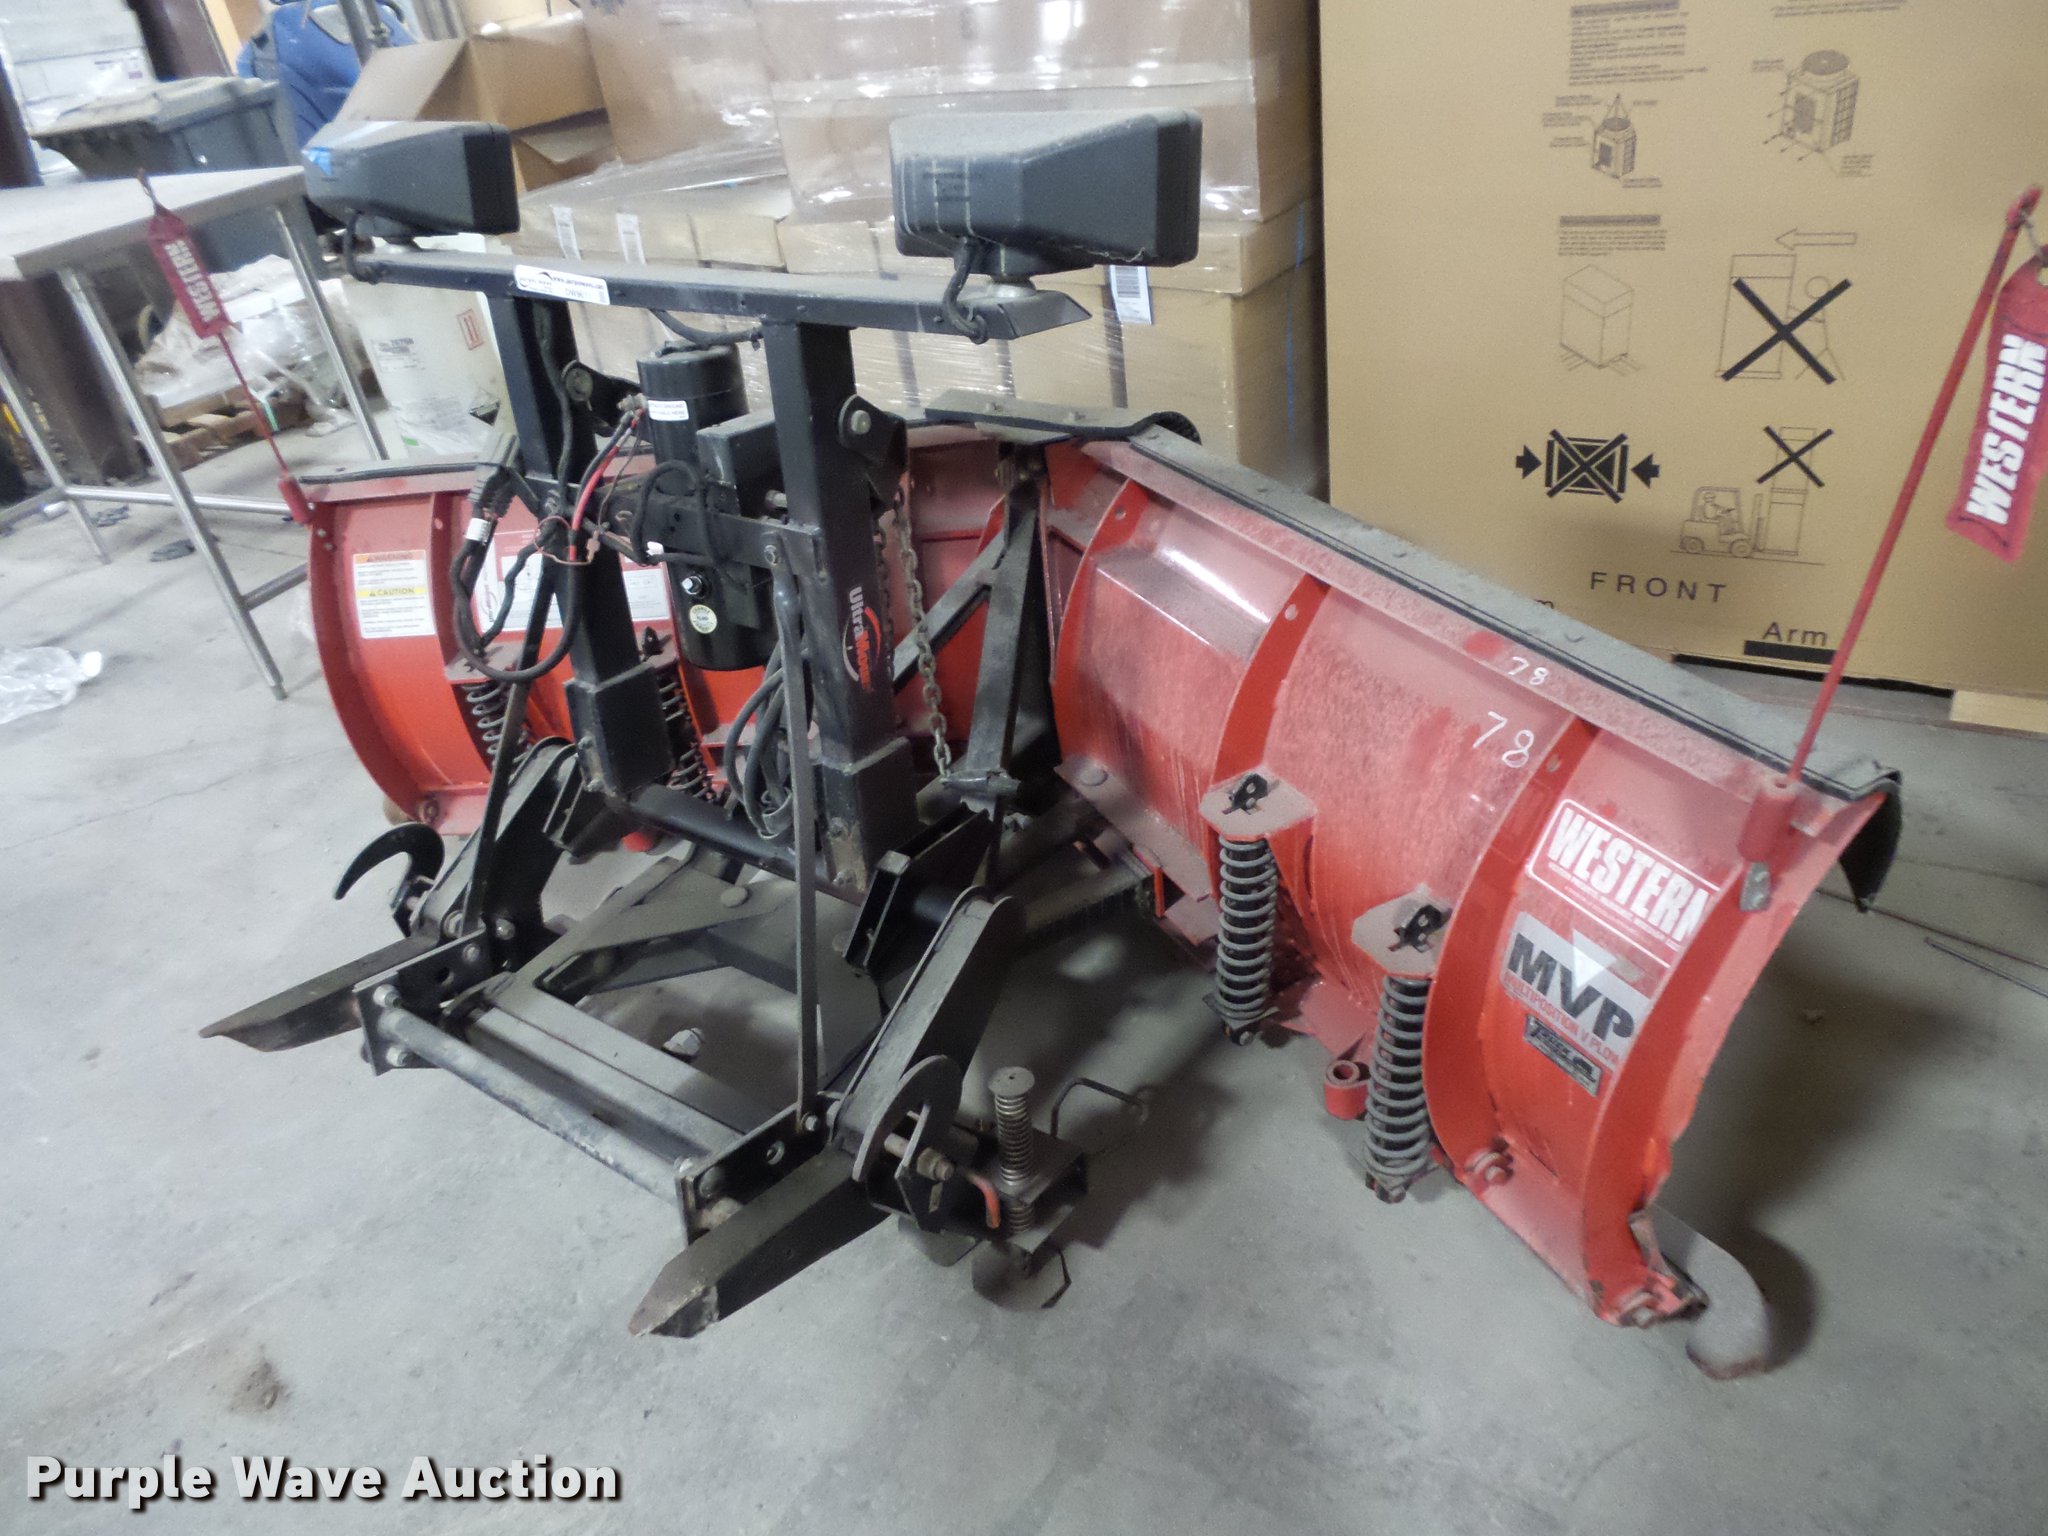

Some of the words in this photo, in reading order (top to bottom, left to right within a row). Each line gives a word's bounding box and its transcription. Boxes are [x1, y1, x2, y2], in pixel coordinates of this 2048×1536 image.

[164, 240, 220, 322] WESTERN
[1965, 333, 2047, 525] WESTERN
[1590, 571, 1726, 603] FRONT
[1762, 622, 1828, 647] Arm
[1508, 656, 1549, 685] 78
[1472, 711, 1534, 768] 78
[1508, 933, 1634, 1041] MVP
